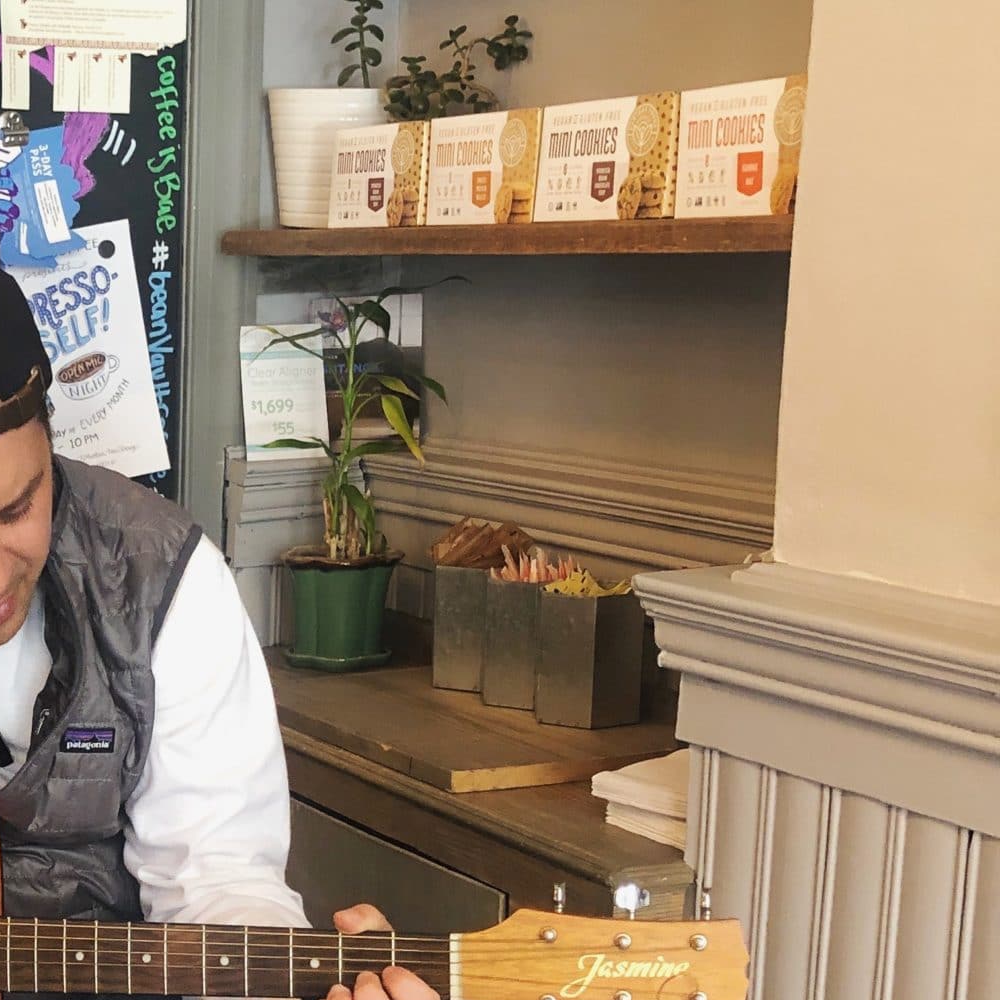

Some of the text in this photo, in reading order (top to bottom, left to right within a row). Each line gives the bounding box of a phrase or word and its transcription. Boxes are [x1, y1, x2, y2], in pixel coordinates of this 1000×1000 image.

[548, 126, 619, 159] MINI COOKIES
[687, 113, 766, 149] MINI COOKIES
[29, 149, 43, 177] PASS
[39, 144, 53, 177] 3-DAY
[147, 144, 176, 174] is
[337, 148, 386, 175] MINI COOKIES
[436, 139, 494, 168] MINI COOKIES
[60, 358, 103, 381] OPEN MIC
[69, 375, 106, 397] NIGHT
[79, 407, 107, 430] EVERY
[106, 378, 130, 410] MONTH
[250, 399, 294, 416] $1,699
[69, 436, 82, 449] 10
[84, 432, 99, 445] PM
[273, 421, 295, 435] $55
[66, 741, 110, 751] patagonia
[560, 953, 690, 998] Jasmine
